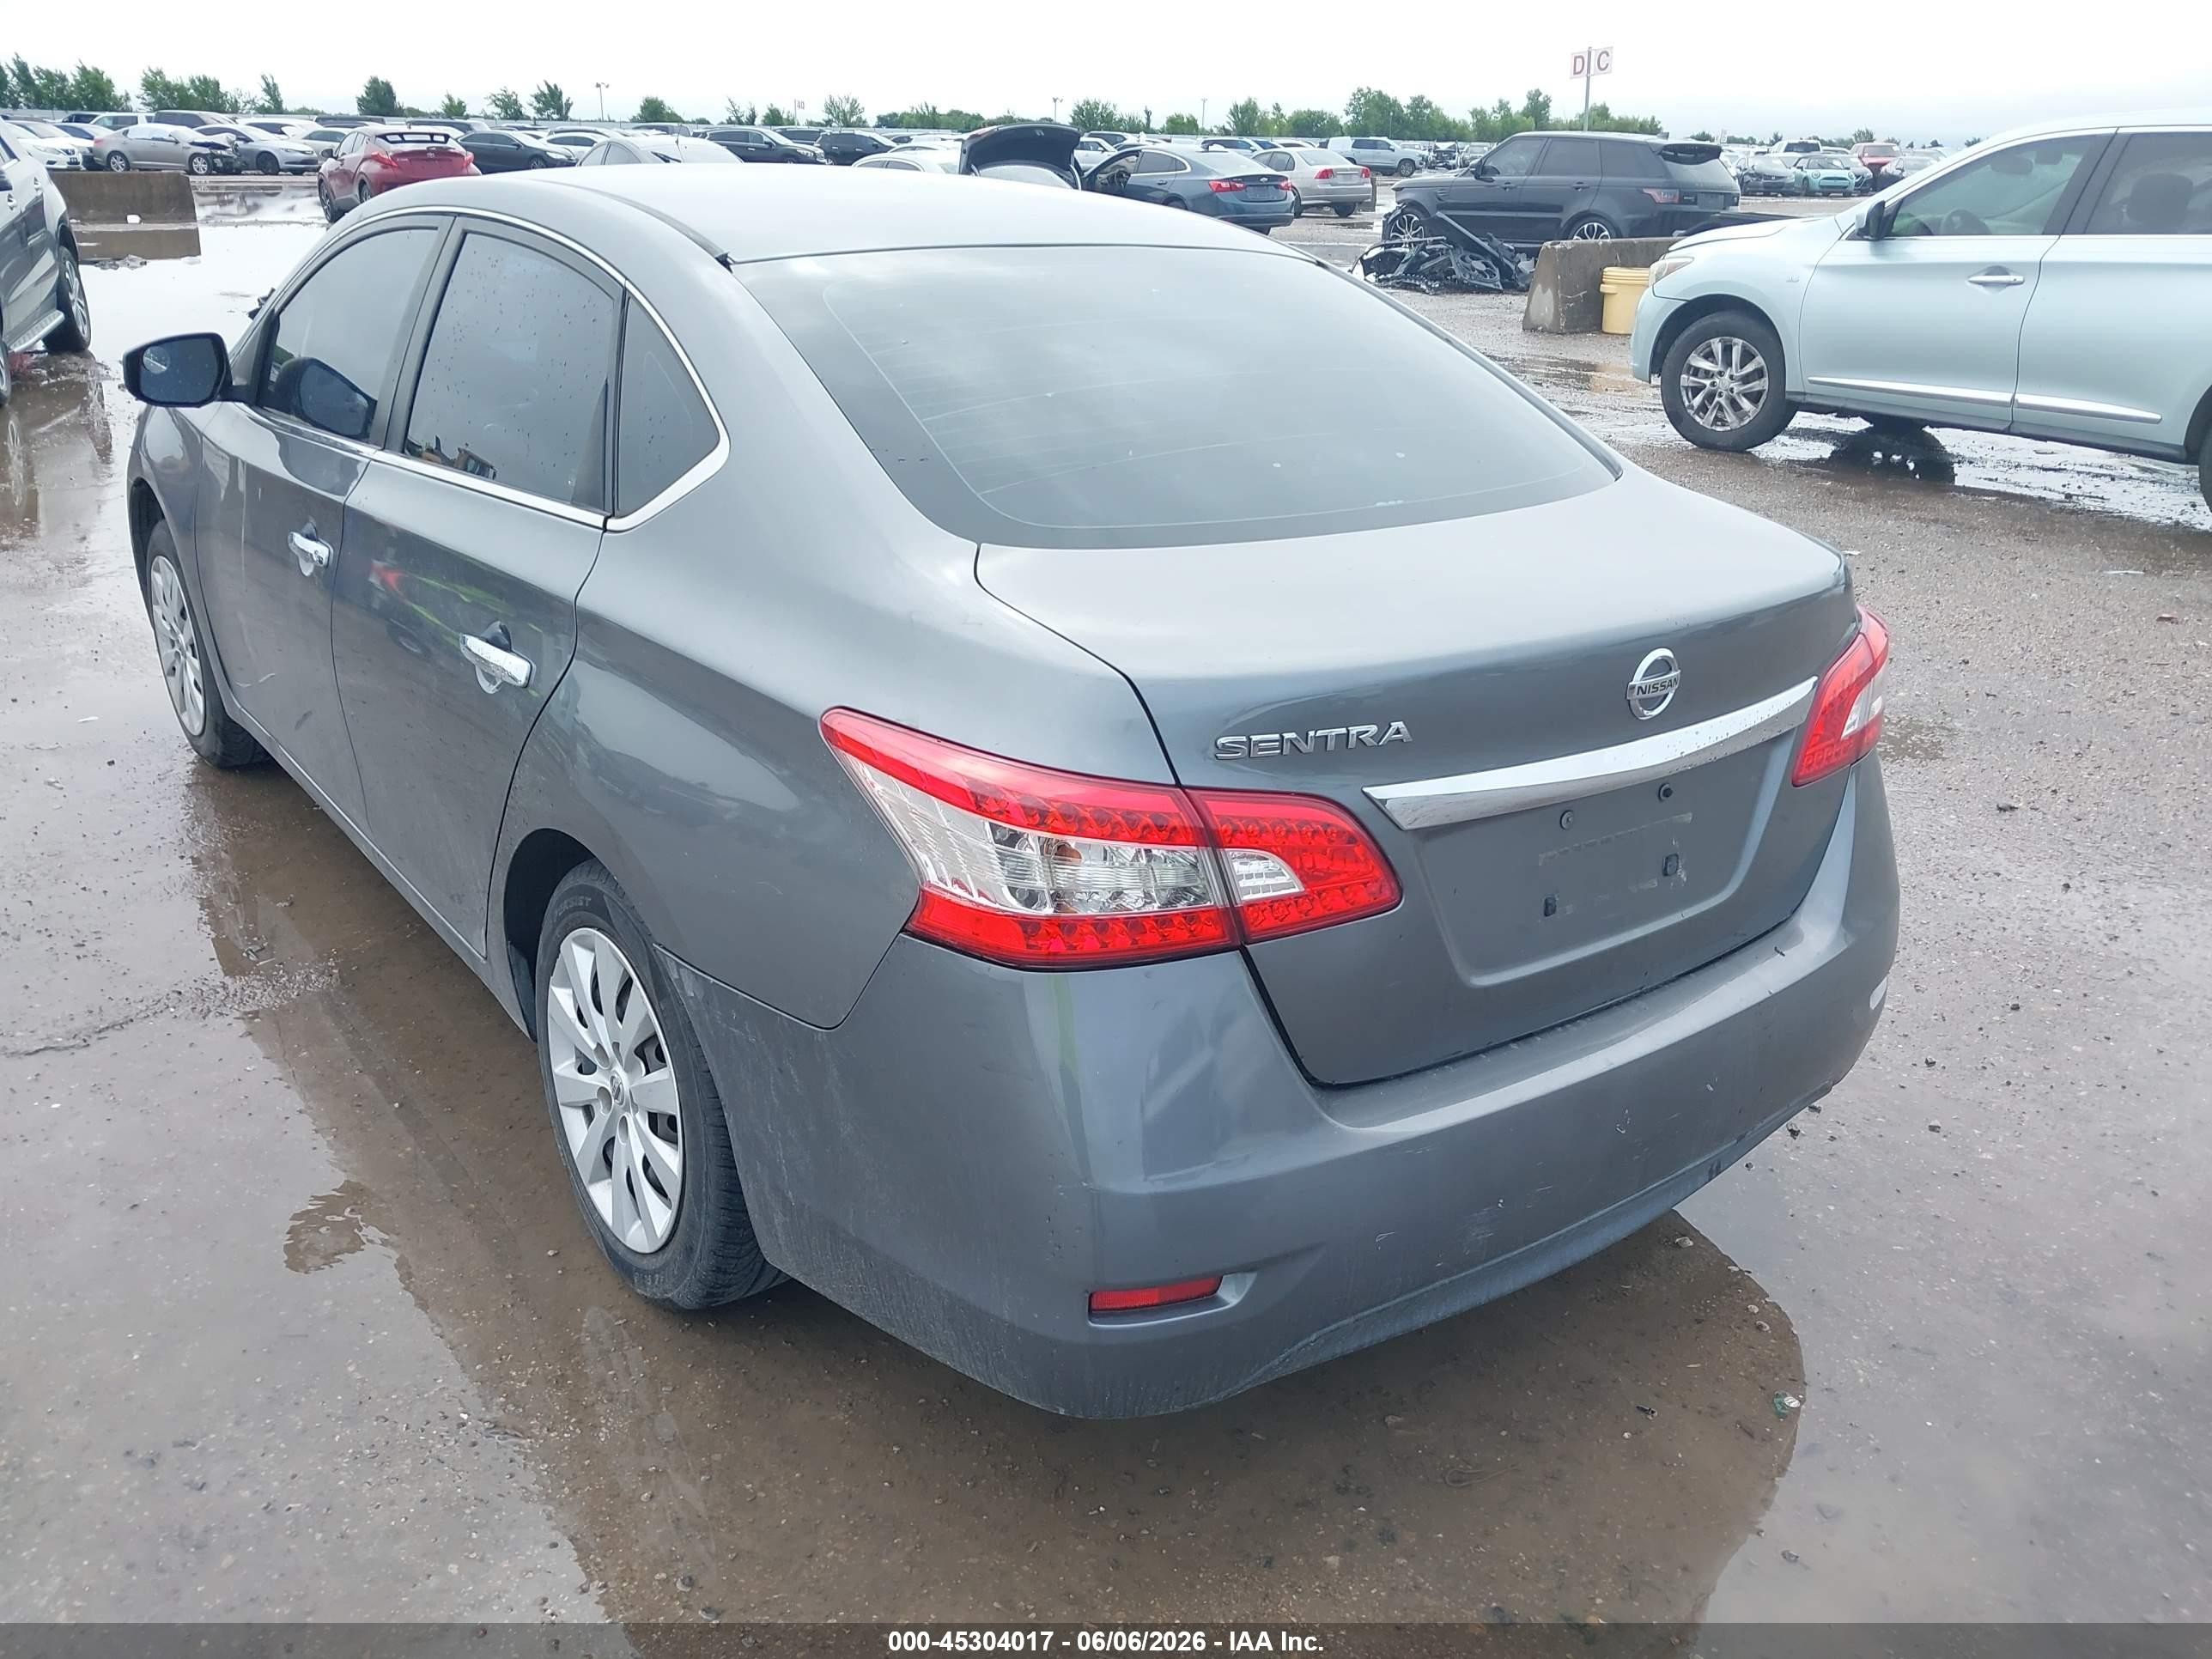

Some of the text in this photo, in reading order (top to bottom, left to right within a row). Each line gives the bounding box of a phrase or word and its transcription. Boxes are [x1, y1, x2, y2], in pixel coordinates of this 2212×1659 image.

[1573, 55, 1585, 76] D
[1597, 50, 1610, 71] C
[1636, 677, 1679, 696] NISSAN
[1215, 720, 1413, 760] SENTRA
